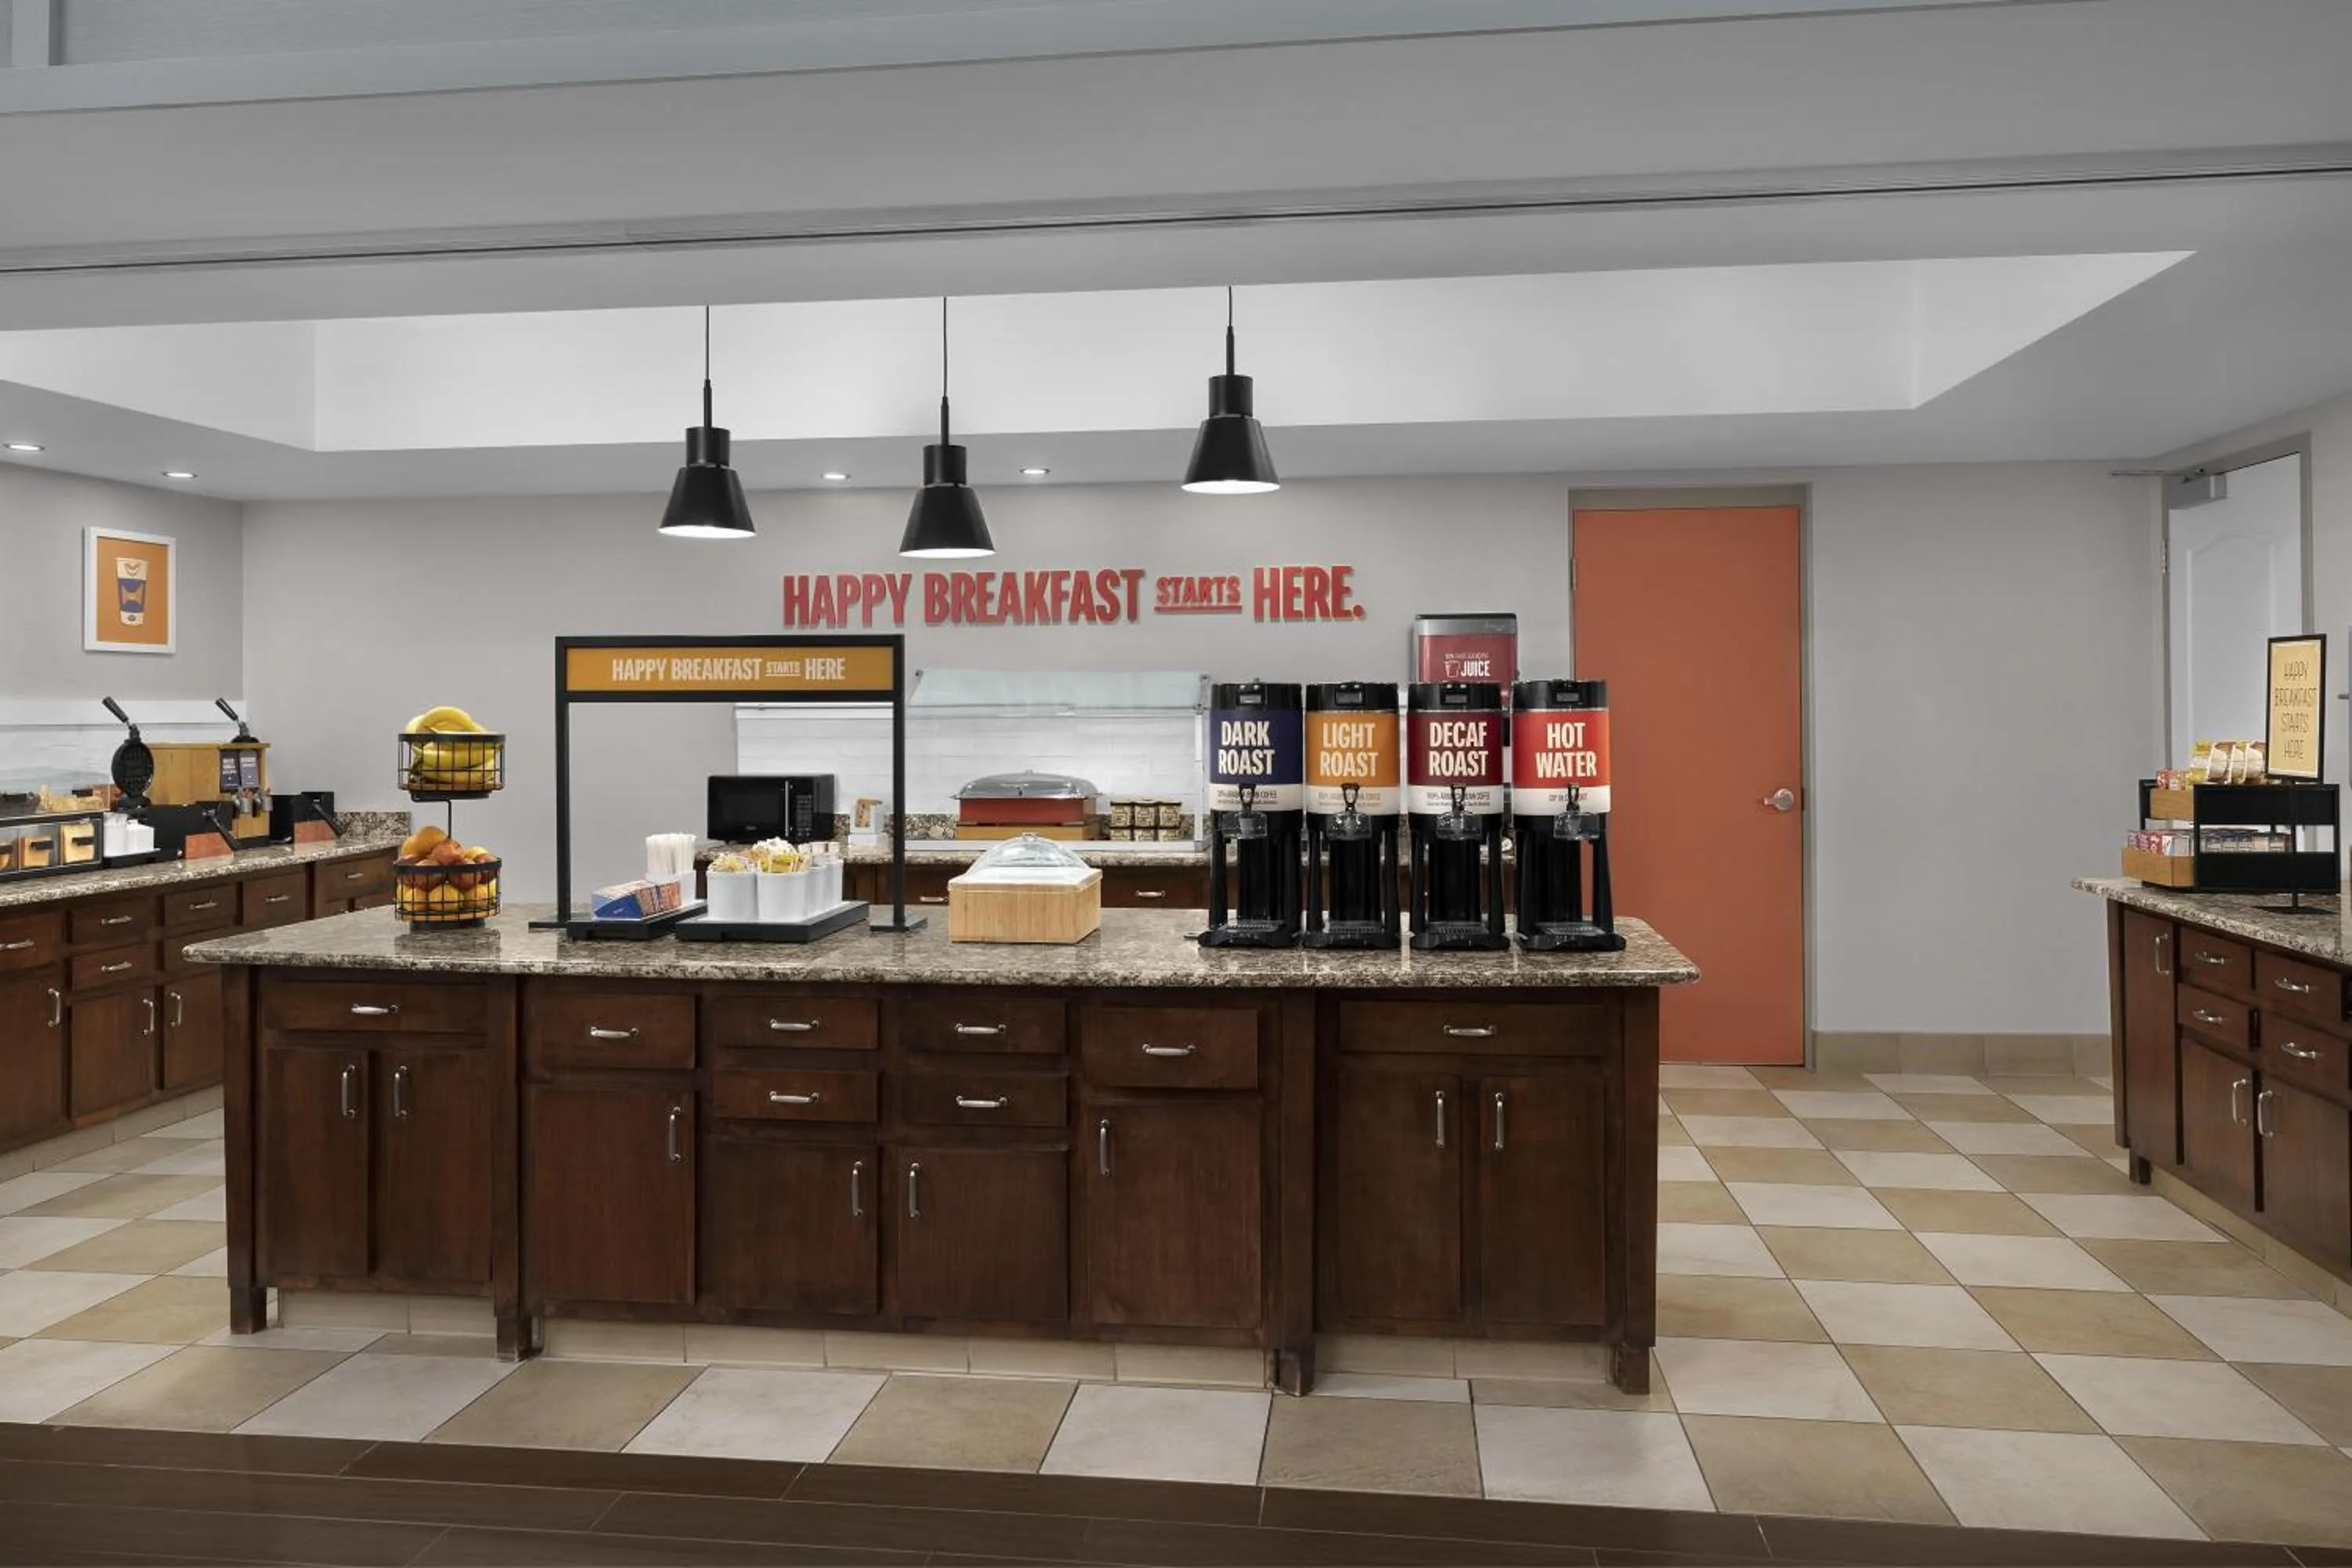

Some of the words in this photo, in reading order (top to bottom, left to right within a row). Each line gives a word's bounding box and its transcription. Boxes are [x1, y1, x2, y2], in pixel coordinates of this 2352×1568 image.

[784, 573, 913, 626] HAPPY
[924, 569, 1145, 626] BREAKFAST
[1156, 576, 1242, 608] STARTS
[1254, 565, 1366, 622] HERE.
[612, 659, 666, 681] HAPPY
[671, 658, 762, 681] BREAKFAST
[766, 662, 800, 675] STARTS
[805, 658, 846, 680] HERE
[1461, 660, 1490, 677] JUICE
[1221, 720, 1271, 746] DARK
[1323, 722, 1376, 748] LIGHT
[1429, 721, 1487, 747] DECAF
[1546, 722, 1586, 749] HOT
[1218, 749, 1276, 775] ROAST
[1319, 751, 1378, 778] ROAST
[1428, 750, 1488, 777] ROAST
[1535, 751, 1597, 779] WATER
